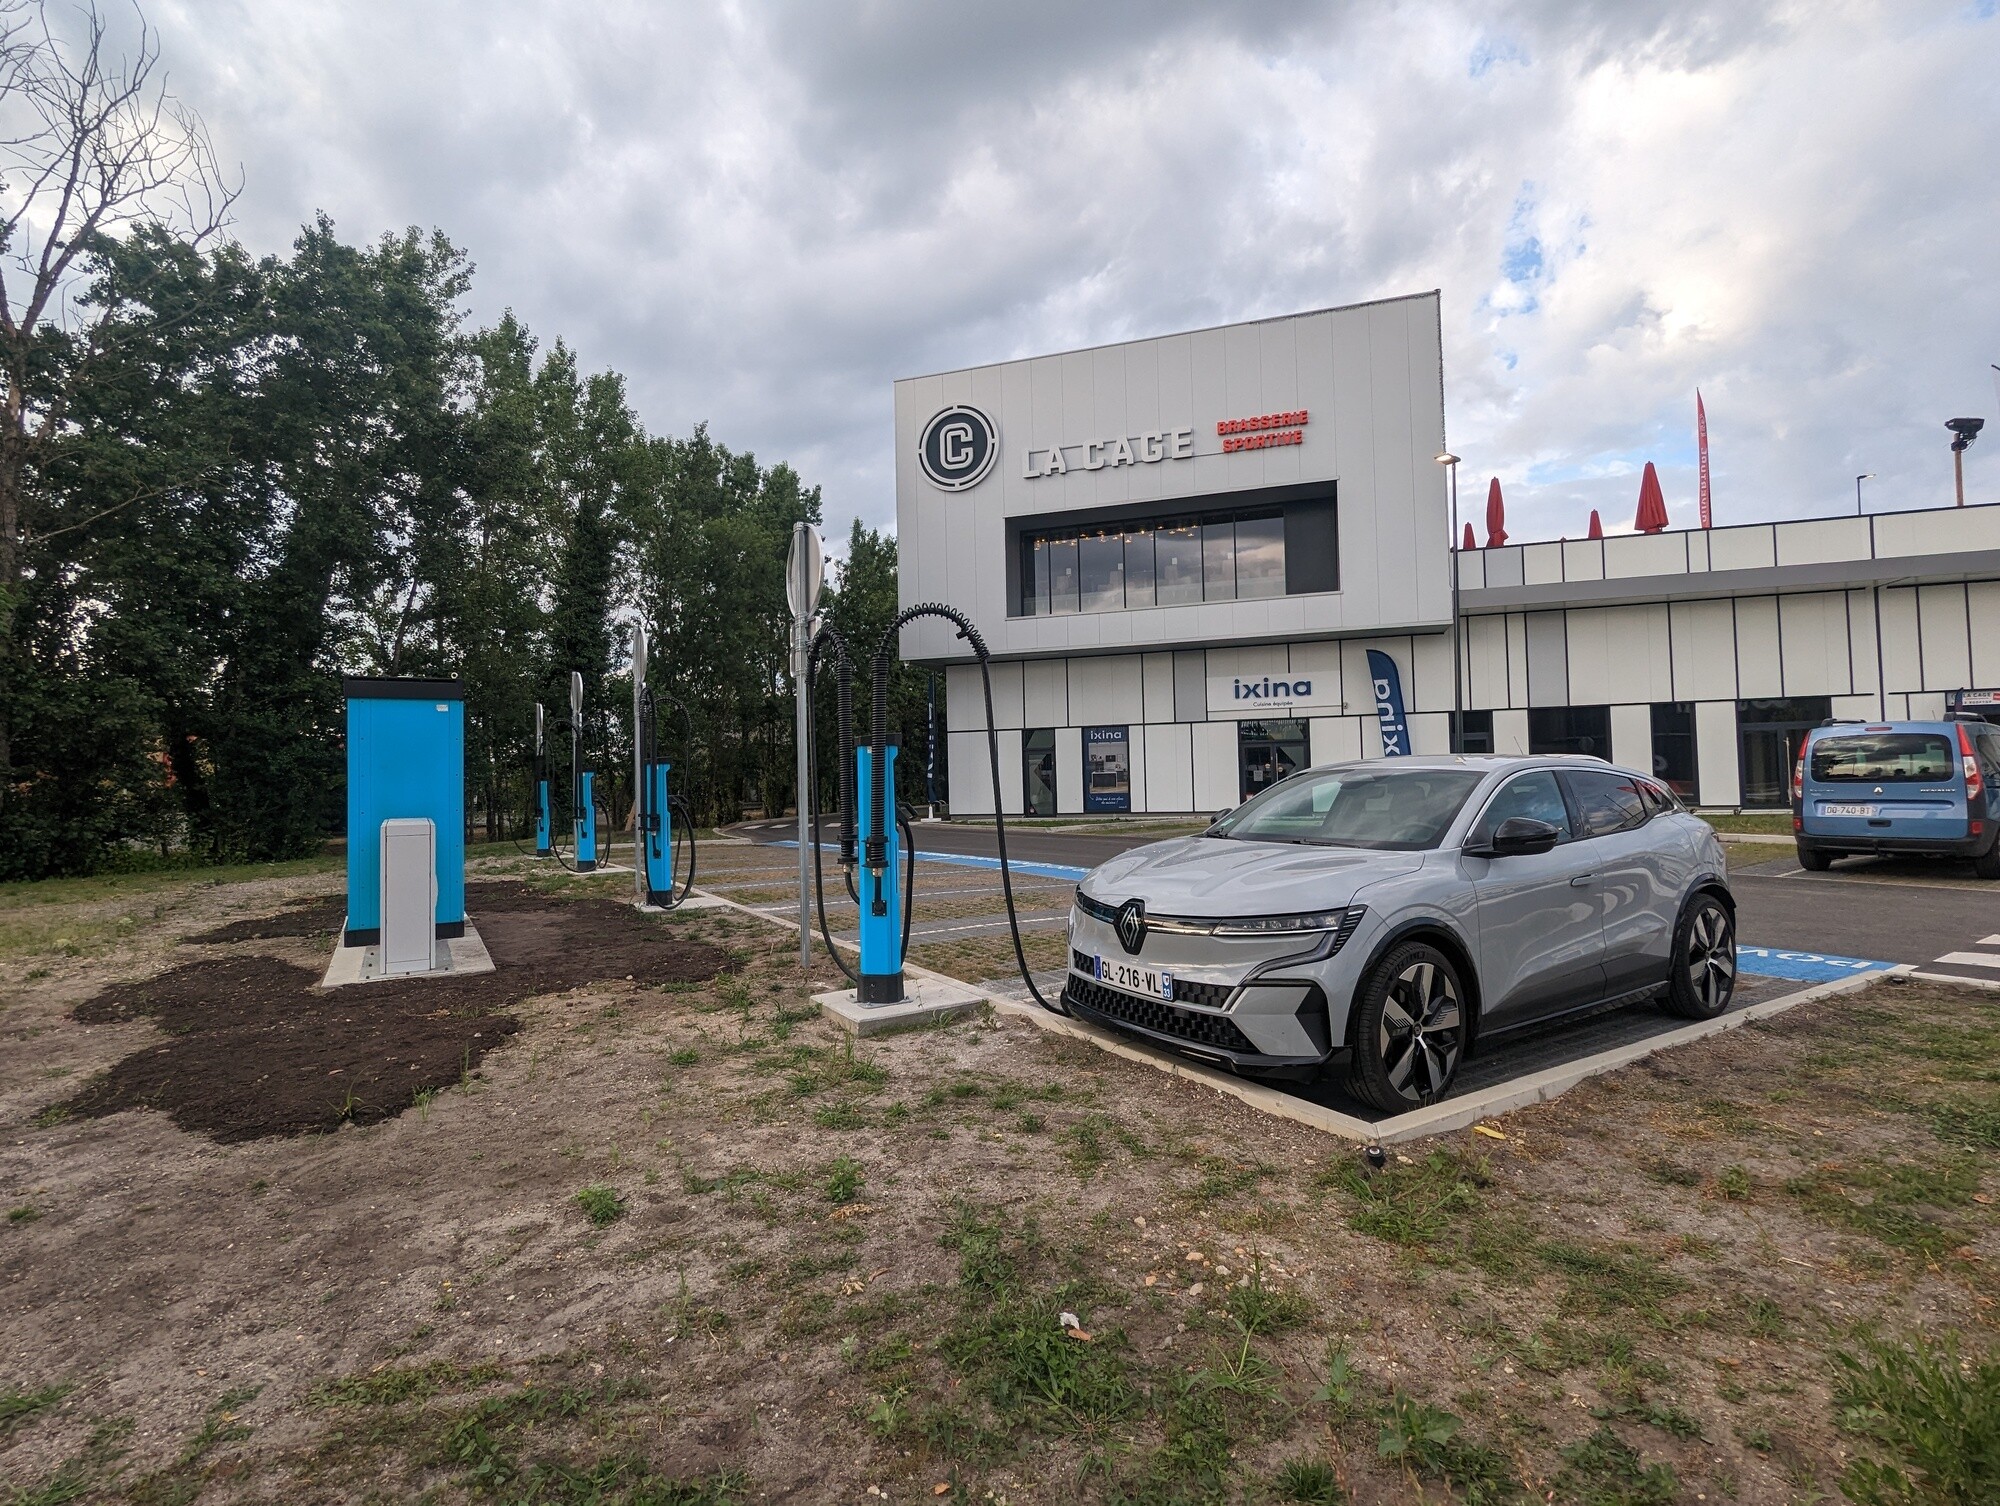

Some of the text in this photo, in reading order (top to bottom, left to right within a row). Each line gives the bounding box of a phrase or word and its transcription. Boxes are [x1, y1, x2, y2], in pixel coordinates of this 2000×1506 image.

[1217, 410, 1308, 435] BRASSERIE
[1022, 426, 1194, 479] LA CAGE
[1222, 430, 1303, 453] SPORTIVE
[1234, 677, 1312, 699] ixina
[1373, 678, 1404, 755] xina
[1090, 730, 1122, 740] ixina
[1163, 988, 1171, 998] 33
